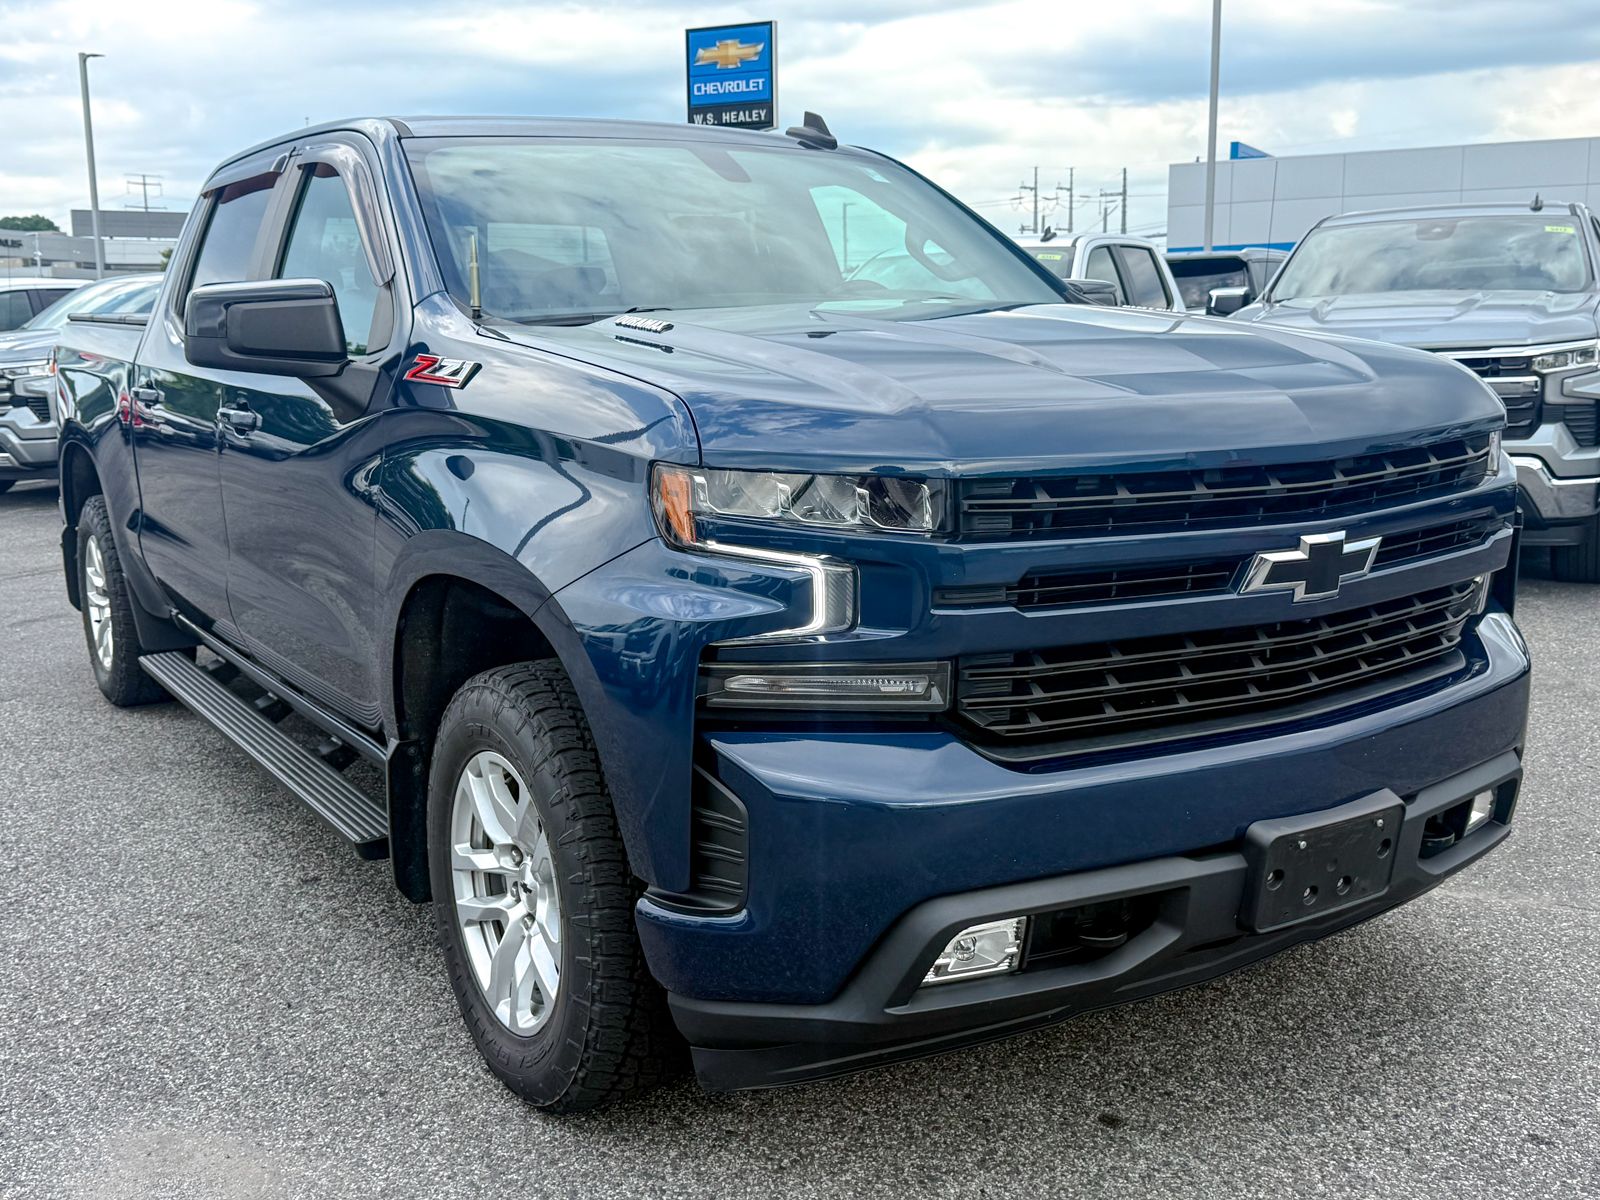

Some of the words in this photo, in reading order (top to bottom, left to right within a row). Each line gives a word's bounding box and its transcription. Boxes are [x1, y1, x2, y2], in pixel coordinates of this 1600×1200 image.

[693, 78, 765, 95] CHEVROLET
[693, 112, 718, 124] W.S.
[722, 109, 766, 123] HEALEY
[614, 314, 675, 334] DURAMAX
[402, 352, 482, 390] Z71
